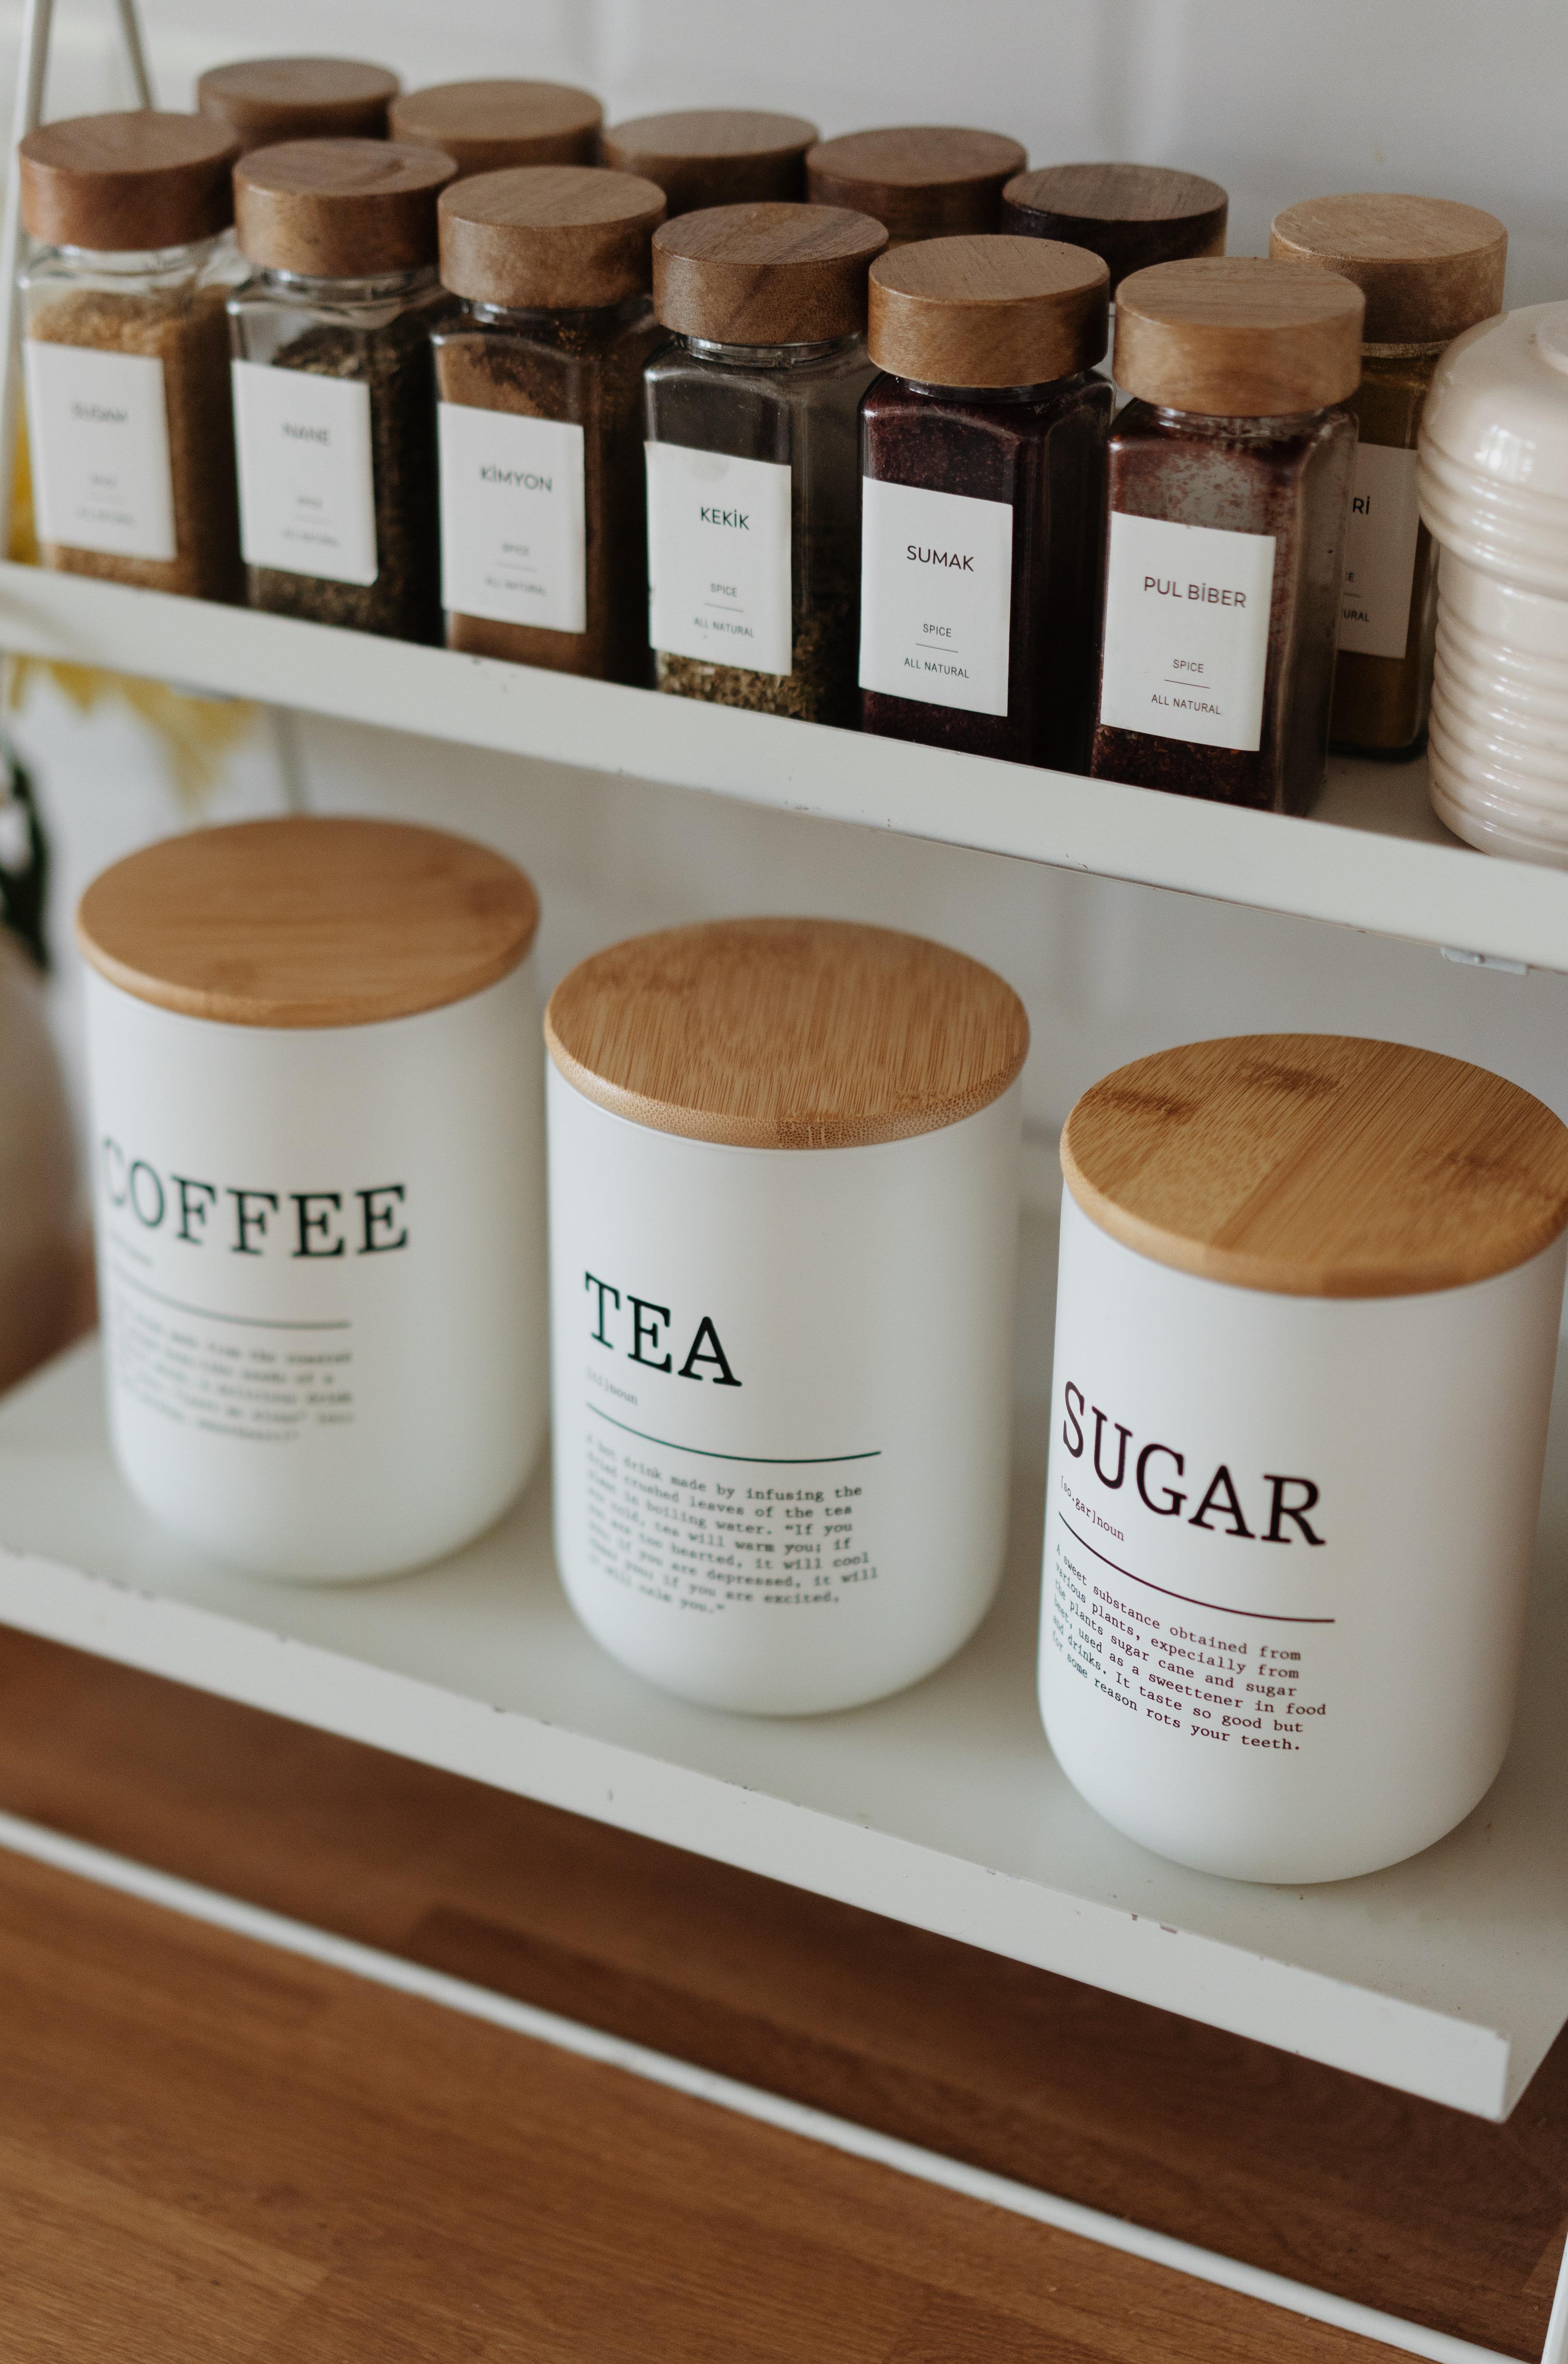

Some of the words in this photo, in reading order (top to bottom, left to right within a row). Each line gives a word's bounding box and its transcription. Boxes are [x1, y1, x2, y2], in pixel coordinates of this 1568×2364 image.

[480, 463, 552, 492] KİMYON
[701, 507, 749, 530] KEKİK
[907, 545, 974, 572] SUMAK
[711, 583, 737, 597] SPICE
[1144, 576, 1182, 598] PUL
[1188, 583, 1247, 608] BİBER
[694, 617, 709, 628] ALL
[713, 621, 754, 638] NATURAL
[923, 624, 952, 637] SPICE
[905, 657, 920, 669] ALL
[925, 662, 969, 678] NATURAL
[1173, 659, 1204, 673] SPICE
[1151, 694, 1169, 706] ALL
[1173, 698, 1221, 715] NATURAL
[104, 1137, 409, 1259] COFFEE
[585, 1270, 743, 1387] TEA
[624, 1457, 661, 1479] drink
[670, 1476, 707, 1492] made
[716, 1484, 736, 1499] by
[746, 1488, 824, 1503] infusing
[835, 1486, 862, 1498] the
[1063, 1380, 1326, 1547] SUGAR
[624, 1476, 679, 1503] crushed
[690, 1495, 744, 1515] leaves
[754, 1506, 774, 1518] of
[785, 1507, 814, 1518] the
[825, 1505, 852, 1516] tea
[646, 1499, 706, 1529] boiling
[716, 1520, 772, 1535] water.
[824, 1522, 853, 1536] you
[655, 1521, 679, 1537] tea
[688, 1532, 724, 1547] will
[735, 1540, 775, 1553] warm
[785, 1542, 821, 1555] you;
[834, 1537, 852, 1550] if
[671, 1563, 696, 1575] are
[814, 1575, 831, 1587] it
[841, 1566, 877, 1583] will
[756, 1558, 772, 1569] it
[783, 1557, 822, 1570] will
[833, 1551, 870, 1568] cool
[664, 1573, 678, 1588] if
[689, 1583, 716, 1597] you
[726, 1591, 753, 1603] are
[1056, 1543, 1061, 1556] A
[1064, 1555, 1087, 1586] sweet
[1093, 1585, 1160, 1629] substance
[1170, 1626, 1247, 1655] obtained
[1260, 1645, 1301, 1661] from
[1056, 1561, 1086, 1603] various
[1092, 1603, 1140, 1641] plants,
[1151, 1637, 1246, 1674] expecially
[1259, 1663, 1300, 1679] from
[1055, 1579, 1066, 1600] the
[1070, 1600, 1103, 1635] plants
[1111, 1634, 1149, 1661] sugar
[1158, 1658, 1194, 1678] cane
[1205, 1674, 1234, 1688] and
[1246, 1682, 1297, 1698] sugar
[1068, 1634, 1107, 1674] drinks.
[1116, 1671, 1130, 1689] It
[1139, 1685, 1182, 1711] taste
[1193, 1707, 1211, 1719] so
[1222, 1715, 1262, 1729] good
[1274, 1719, 1304, 1733] but
[1079, 1627, 1102, 1653] used
[1109, 1652, 1123, 1667] as
[1132, 1664, 1139, 1676] a
[1149, 1673, 1244, 1708] sweettener
[1255, 1700, 1274, 1713] in
[1286, 1702, 1327, 1716] food
[1067, 1653, 1088, 1679] some
[1094, 1677, 1138, 1711] reason
[1146, 1707, 1181, 1729] rots
[1191, 1724, 1230, 1742] your
[1241, 1734, 1300, 1751] teeth.
